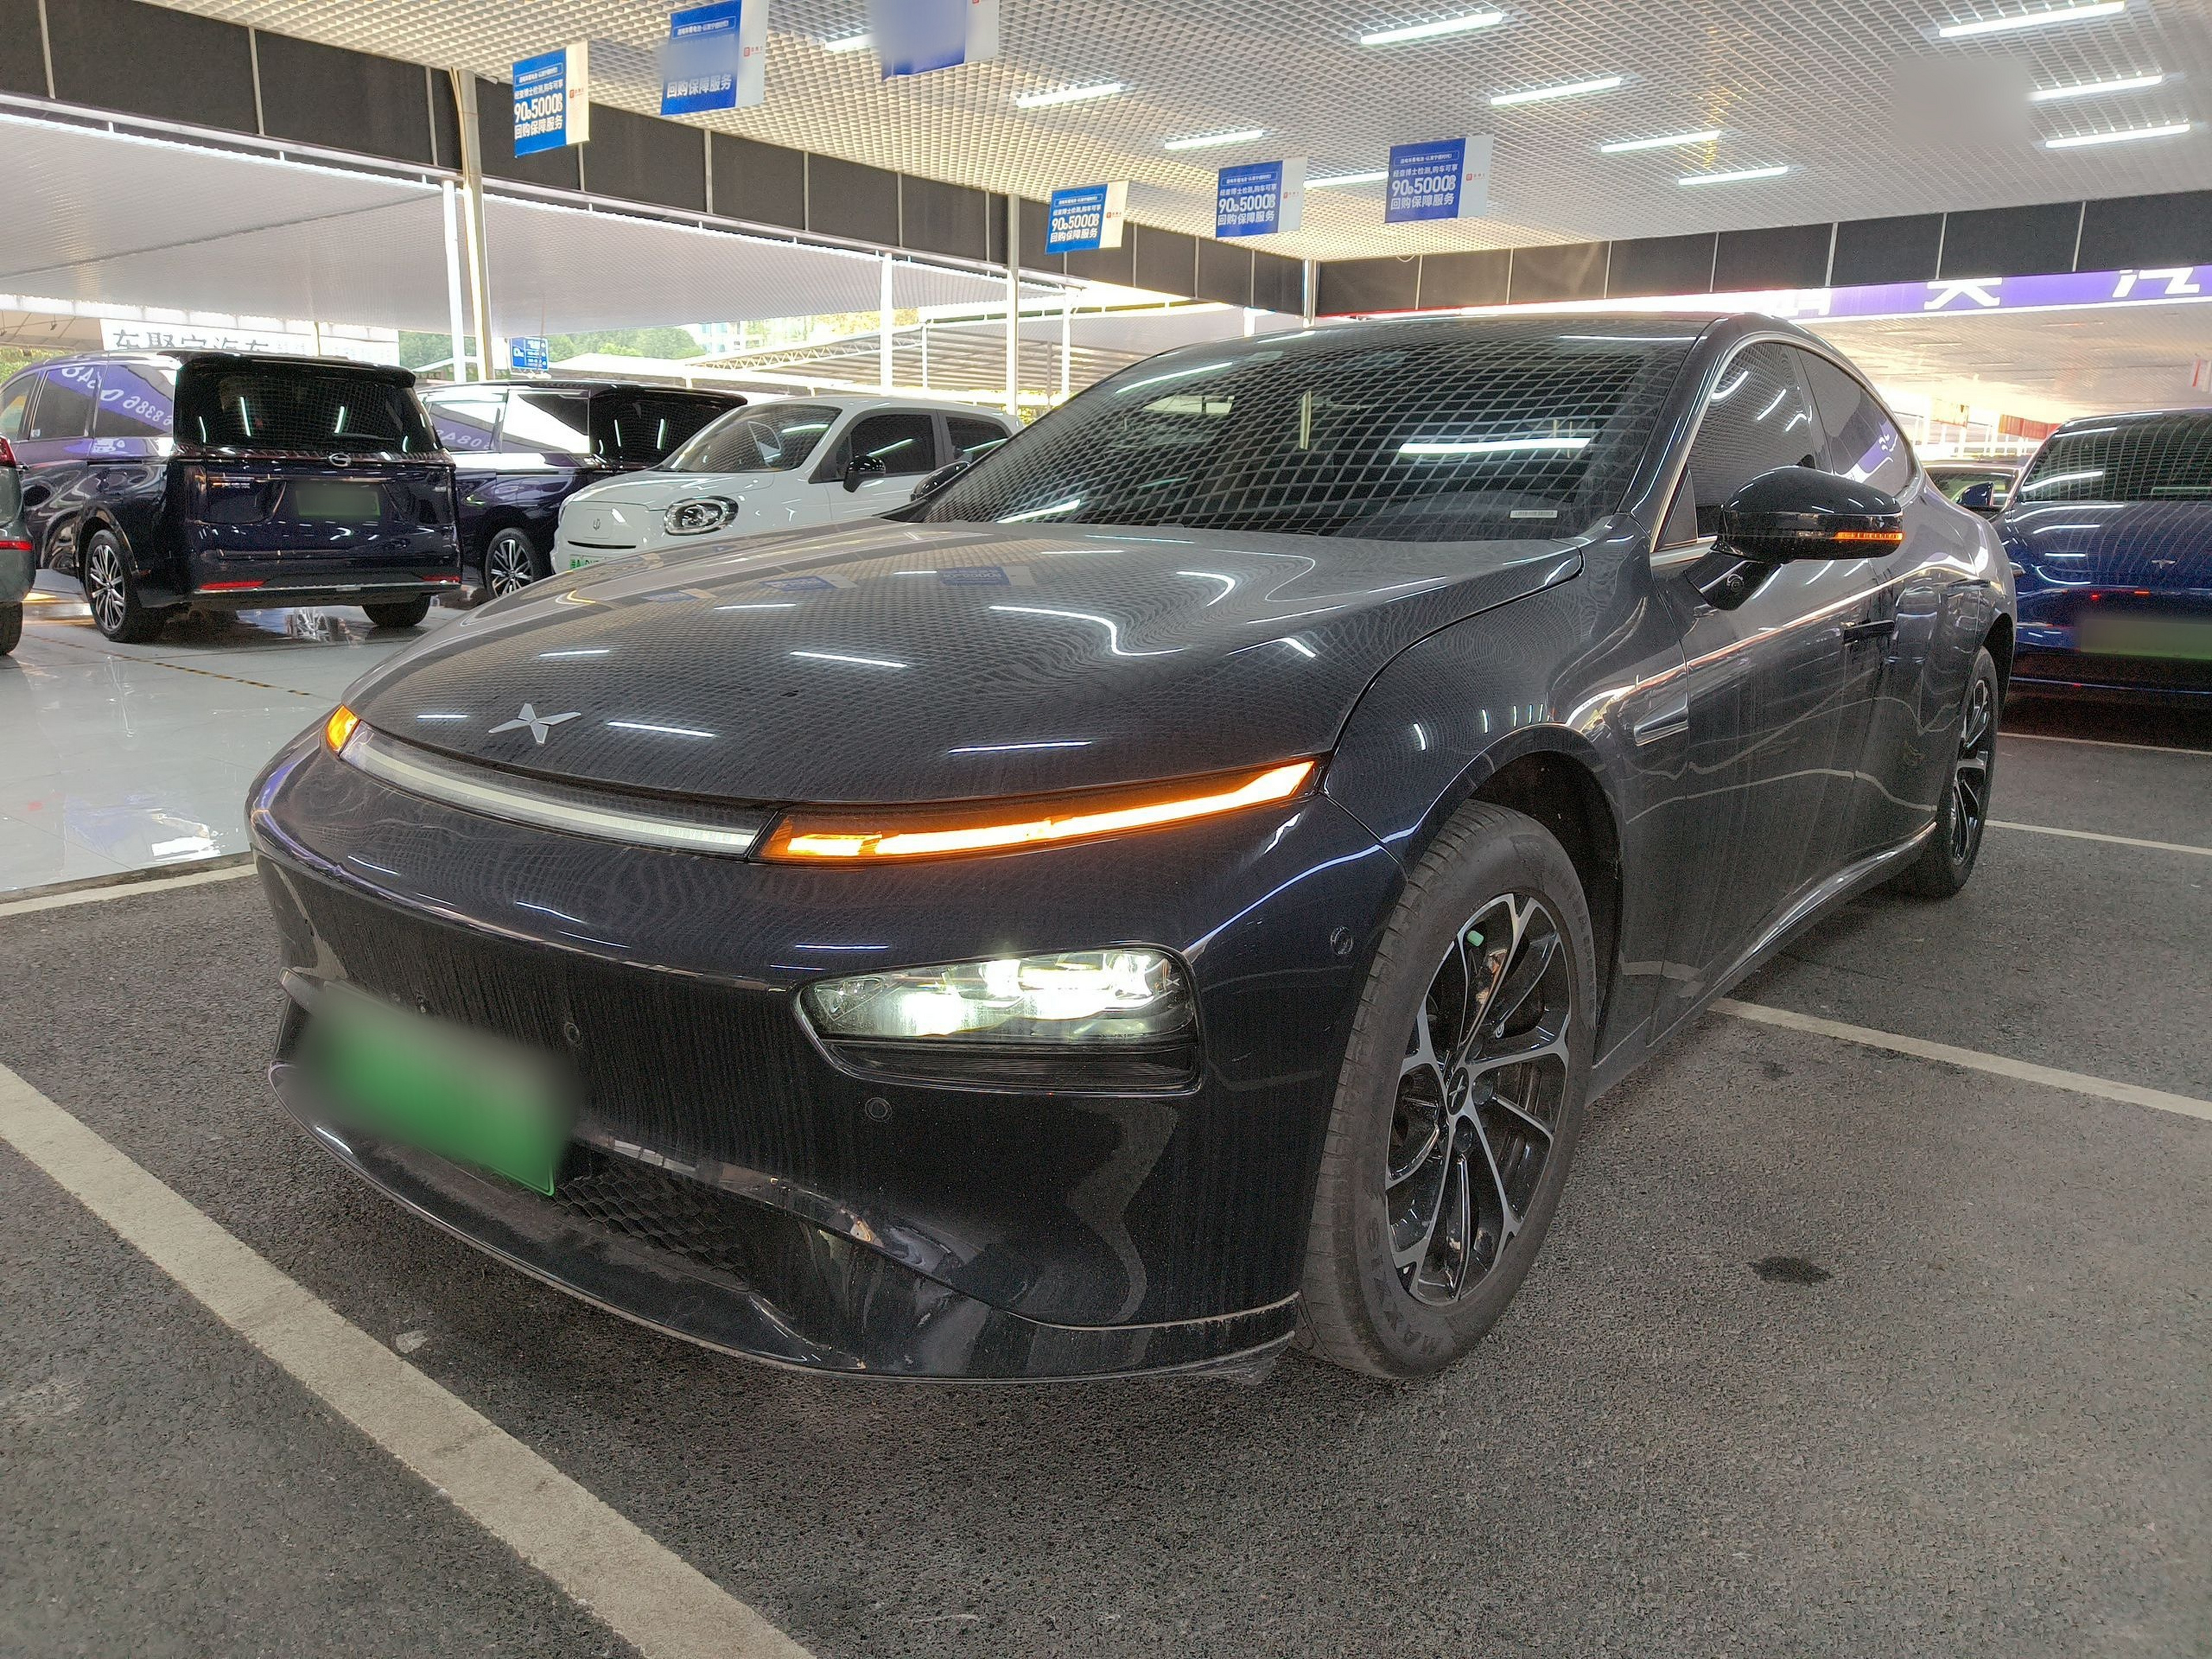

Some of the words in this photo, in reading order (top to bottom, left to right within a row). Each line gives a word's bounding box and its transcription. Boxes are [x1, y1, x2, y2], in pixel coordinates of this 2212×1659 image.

[666, 74, 732, 99] 回购保障服务
[514, 115, 563, 139] 回购保障服务
[1391, 193, 1455, 210] 回购保障服务
[1218, 210, 1275, 226] 回购保障服务
